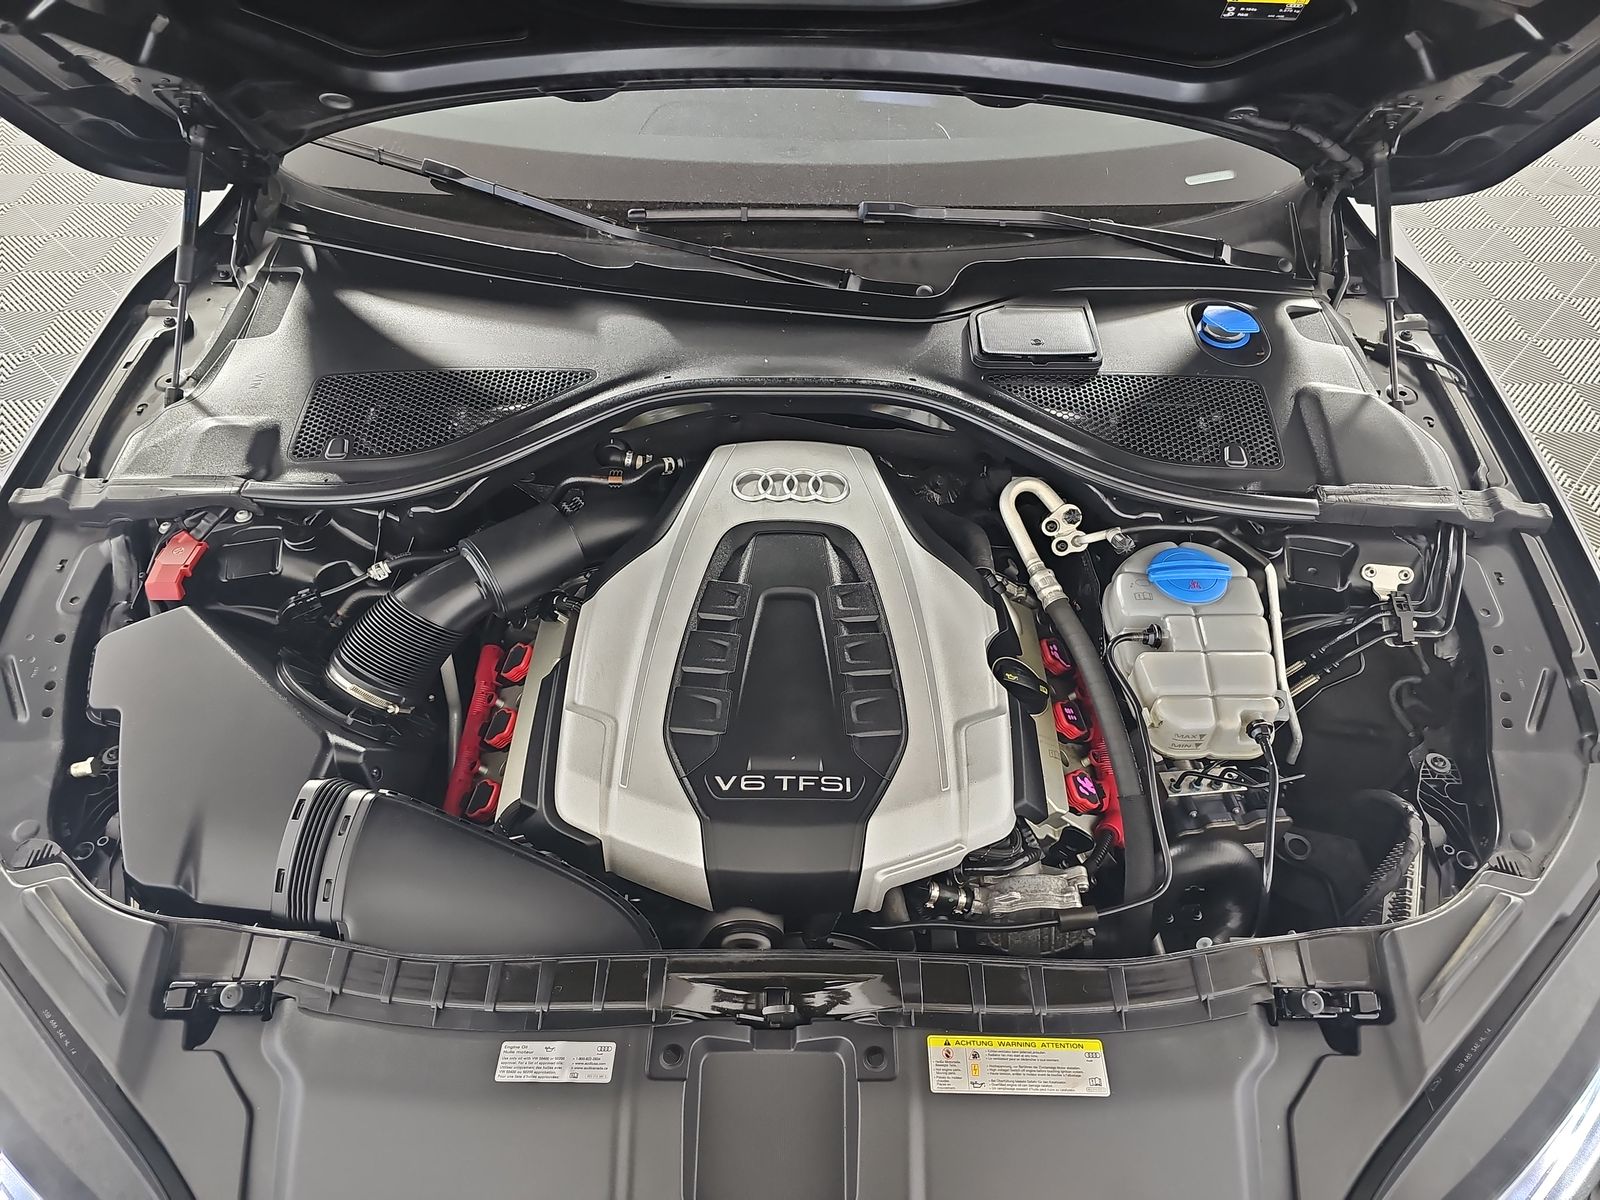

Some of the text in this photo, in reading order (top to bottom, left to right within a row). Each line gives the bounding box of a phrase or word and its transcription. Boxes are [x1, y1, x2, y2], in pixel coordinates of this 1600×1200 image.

[714, 775, 851, 792] V6 TFSI
[1470, 1043, 1480, 1052] SAE
